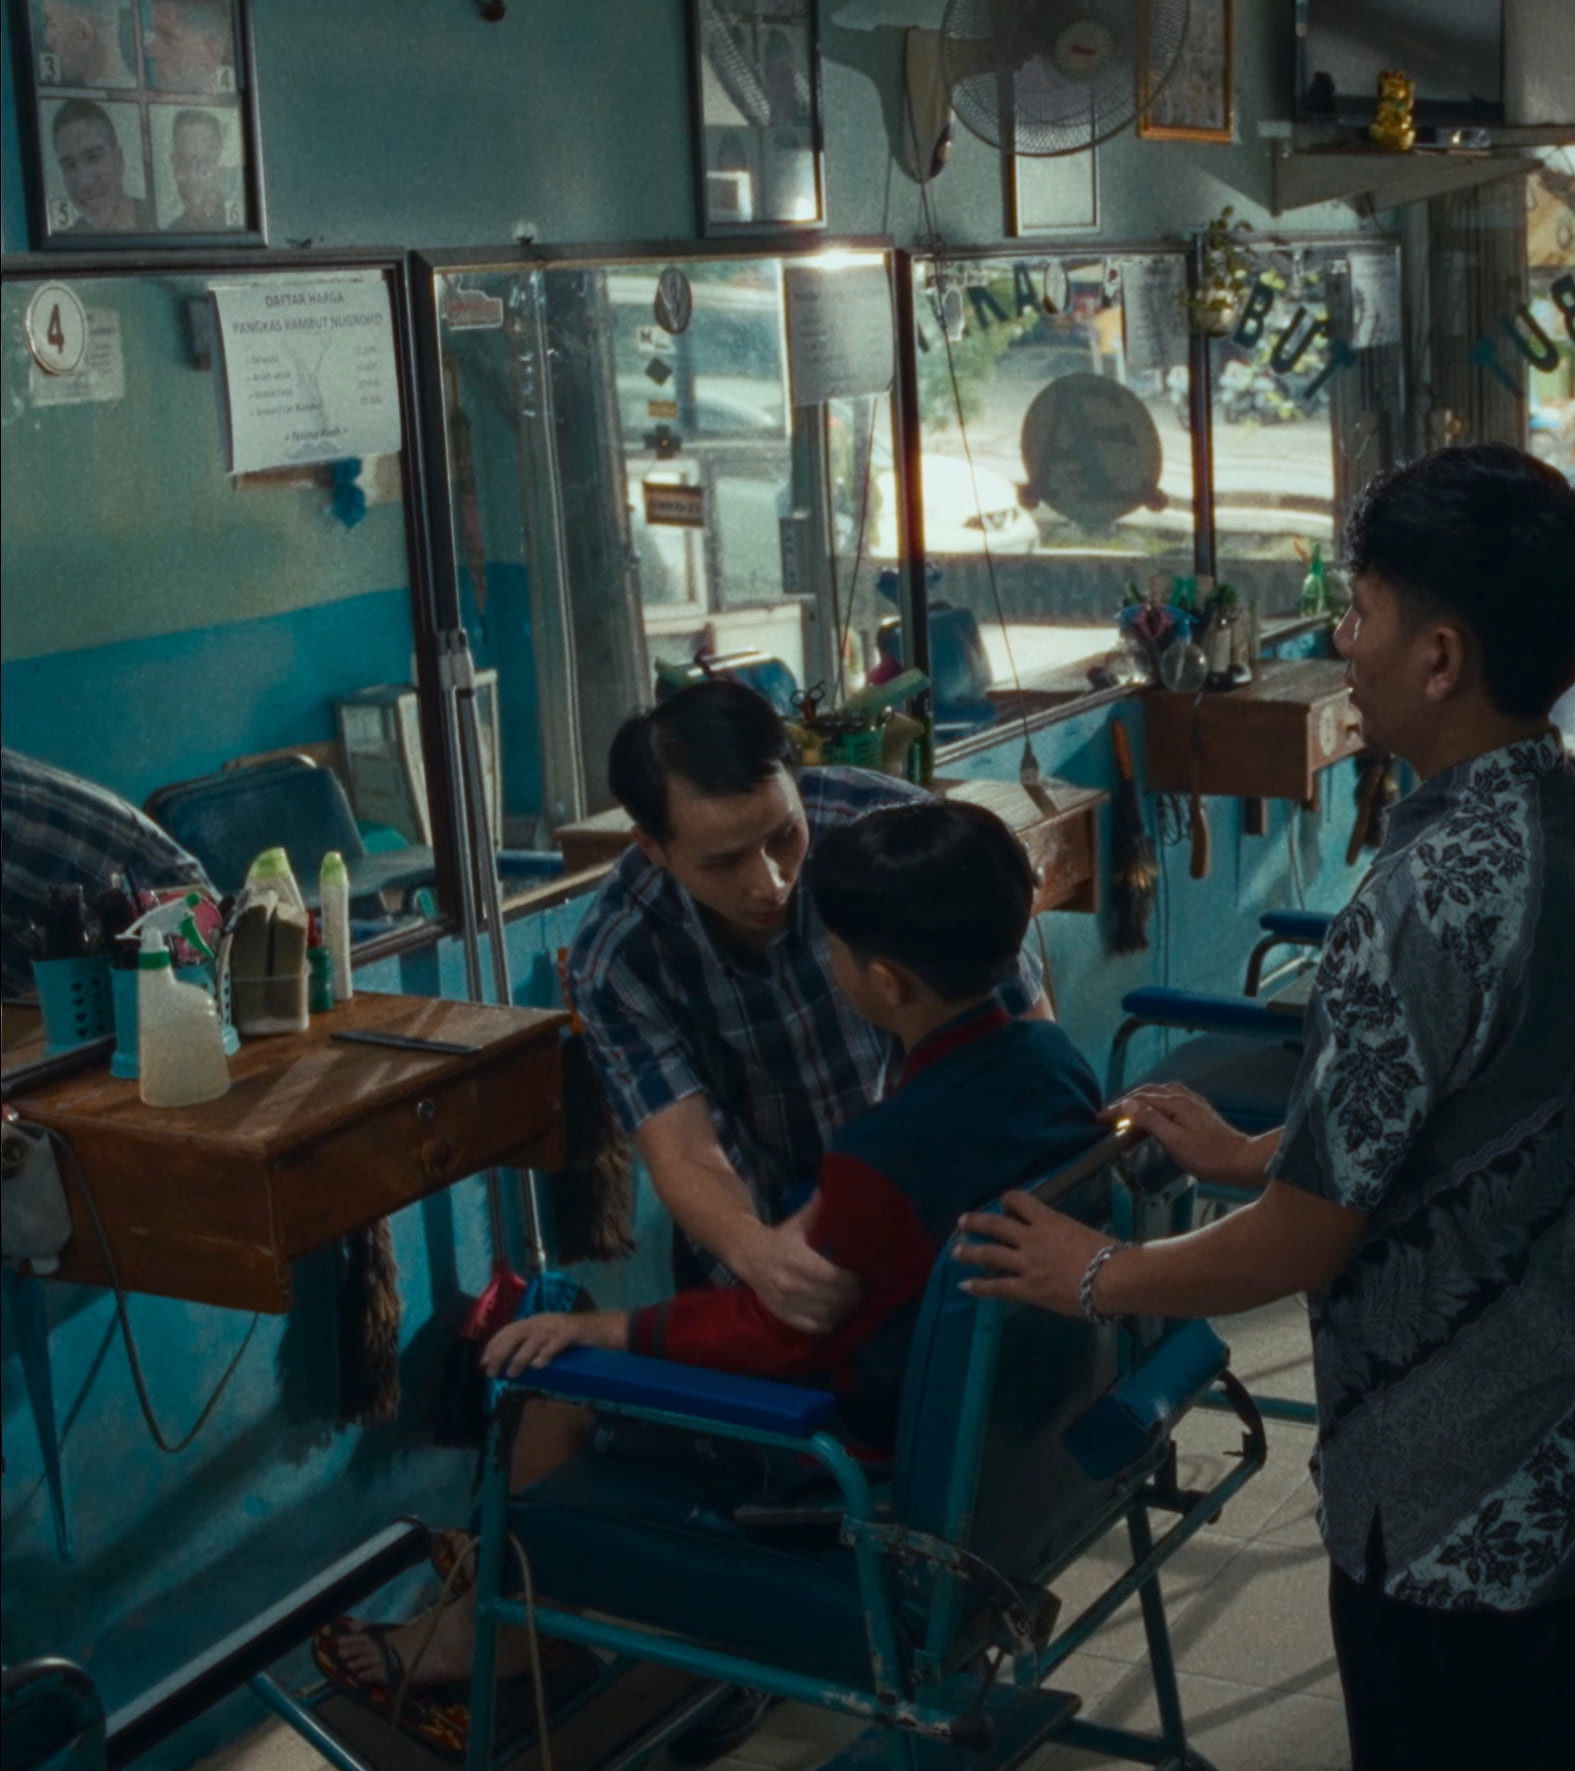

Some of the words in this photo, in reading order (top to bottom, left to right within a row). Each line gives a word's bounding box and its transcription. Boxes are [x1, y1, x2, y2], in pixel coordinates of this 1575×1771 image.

[44, 56, 55, 80] 3
[219, 68, 231, 87] 4
[58, 206, 70, 227] 5
[229, 206, 240, 223] 6
[265, 294, 306, 308] DAFTAR
[307, 290, 345, 304] HARGA
[47, 303, 65, 354] 4
[232, 320, 283, 335] PANGKAS
[284, 317, 330, 332] RAMBUT
[331, 312, 384, 330] NUGROHO
